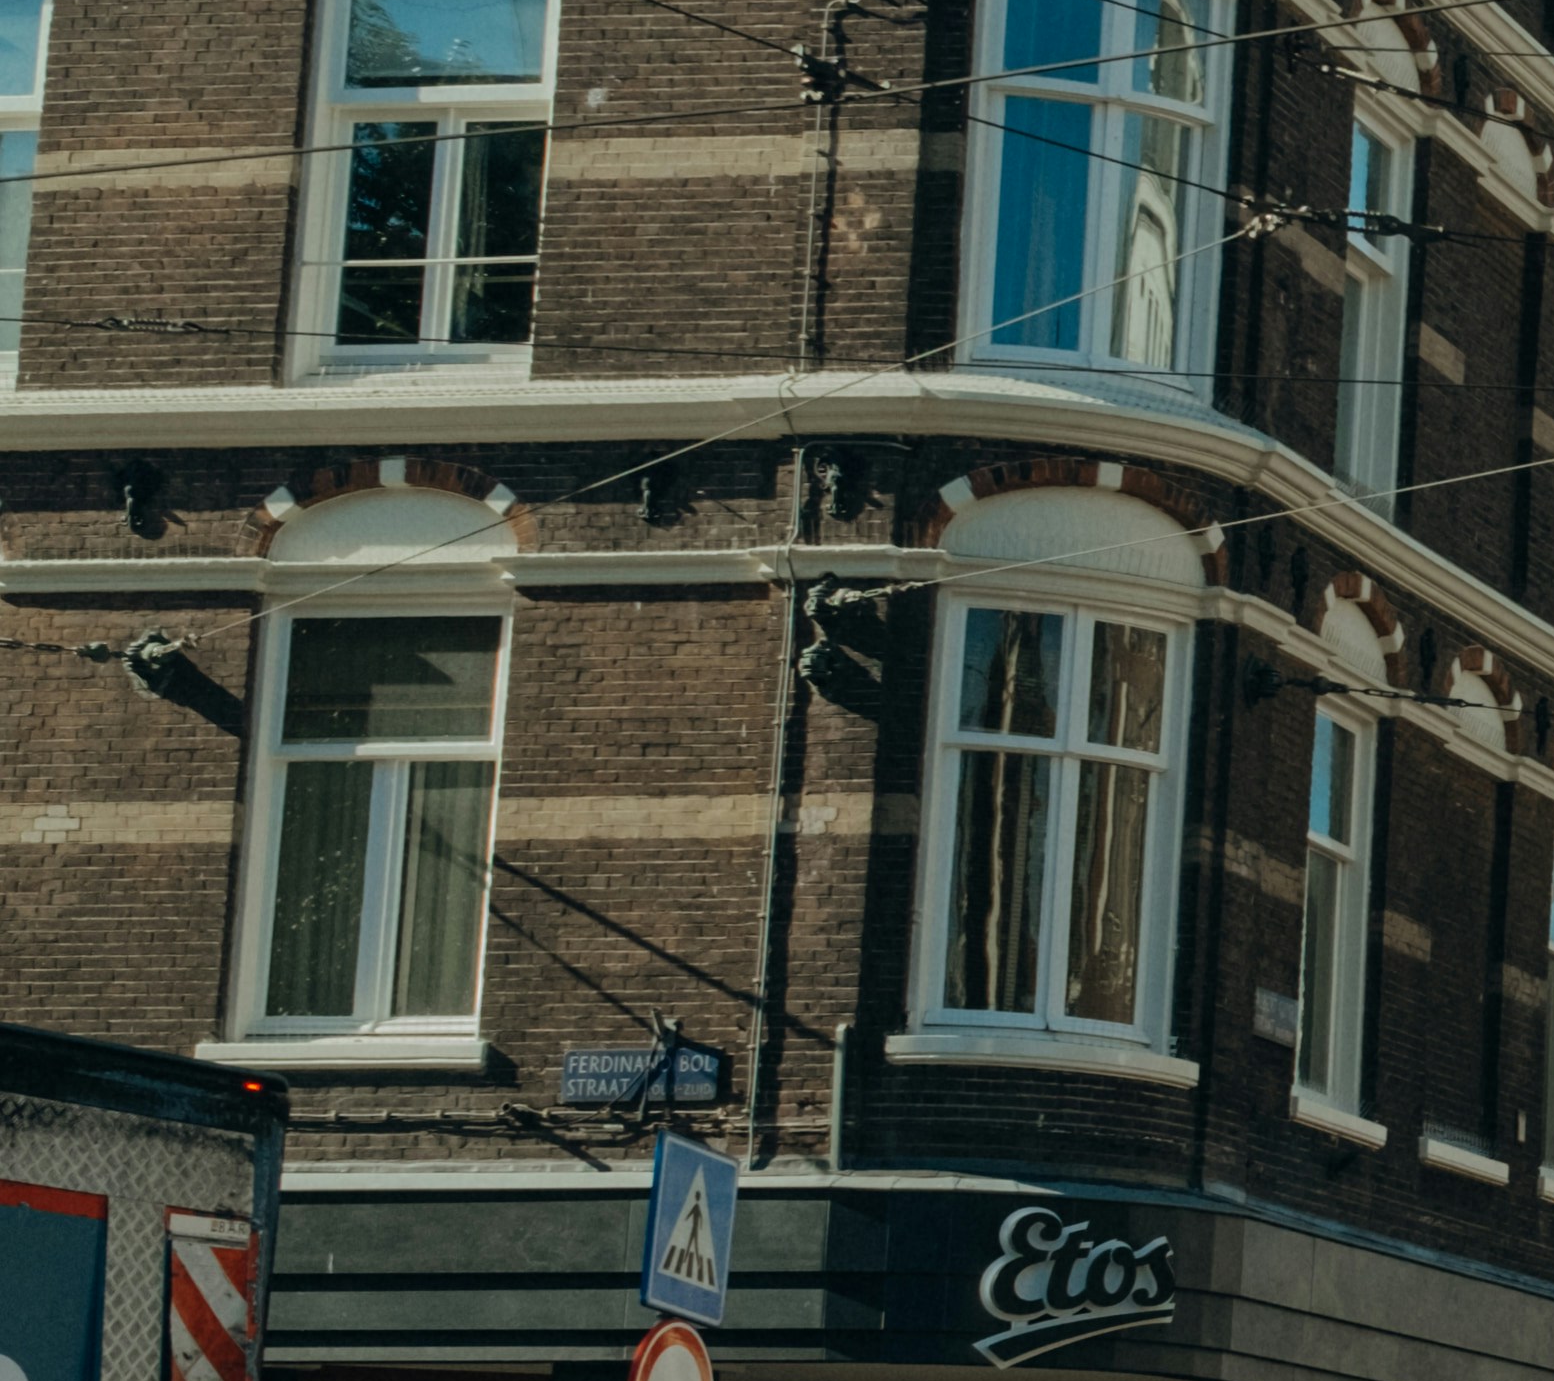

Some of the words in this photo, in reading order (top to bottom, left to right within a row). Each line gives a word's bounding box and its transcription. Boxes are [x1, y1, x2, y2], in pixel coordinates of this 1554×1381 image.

[679, 1054, 713, 1073] BOL
[567, 1078, 632, 1097] STRAAT
[979, 1206, 1176, 1322] Etos
